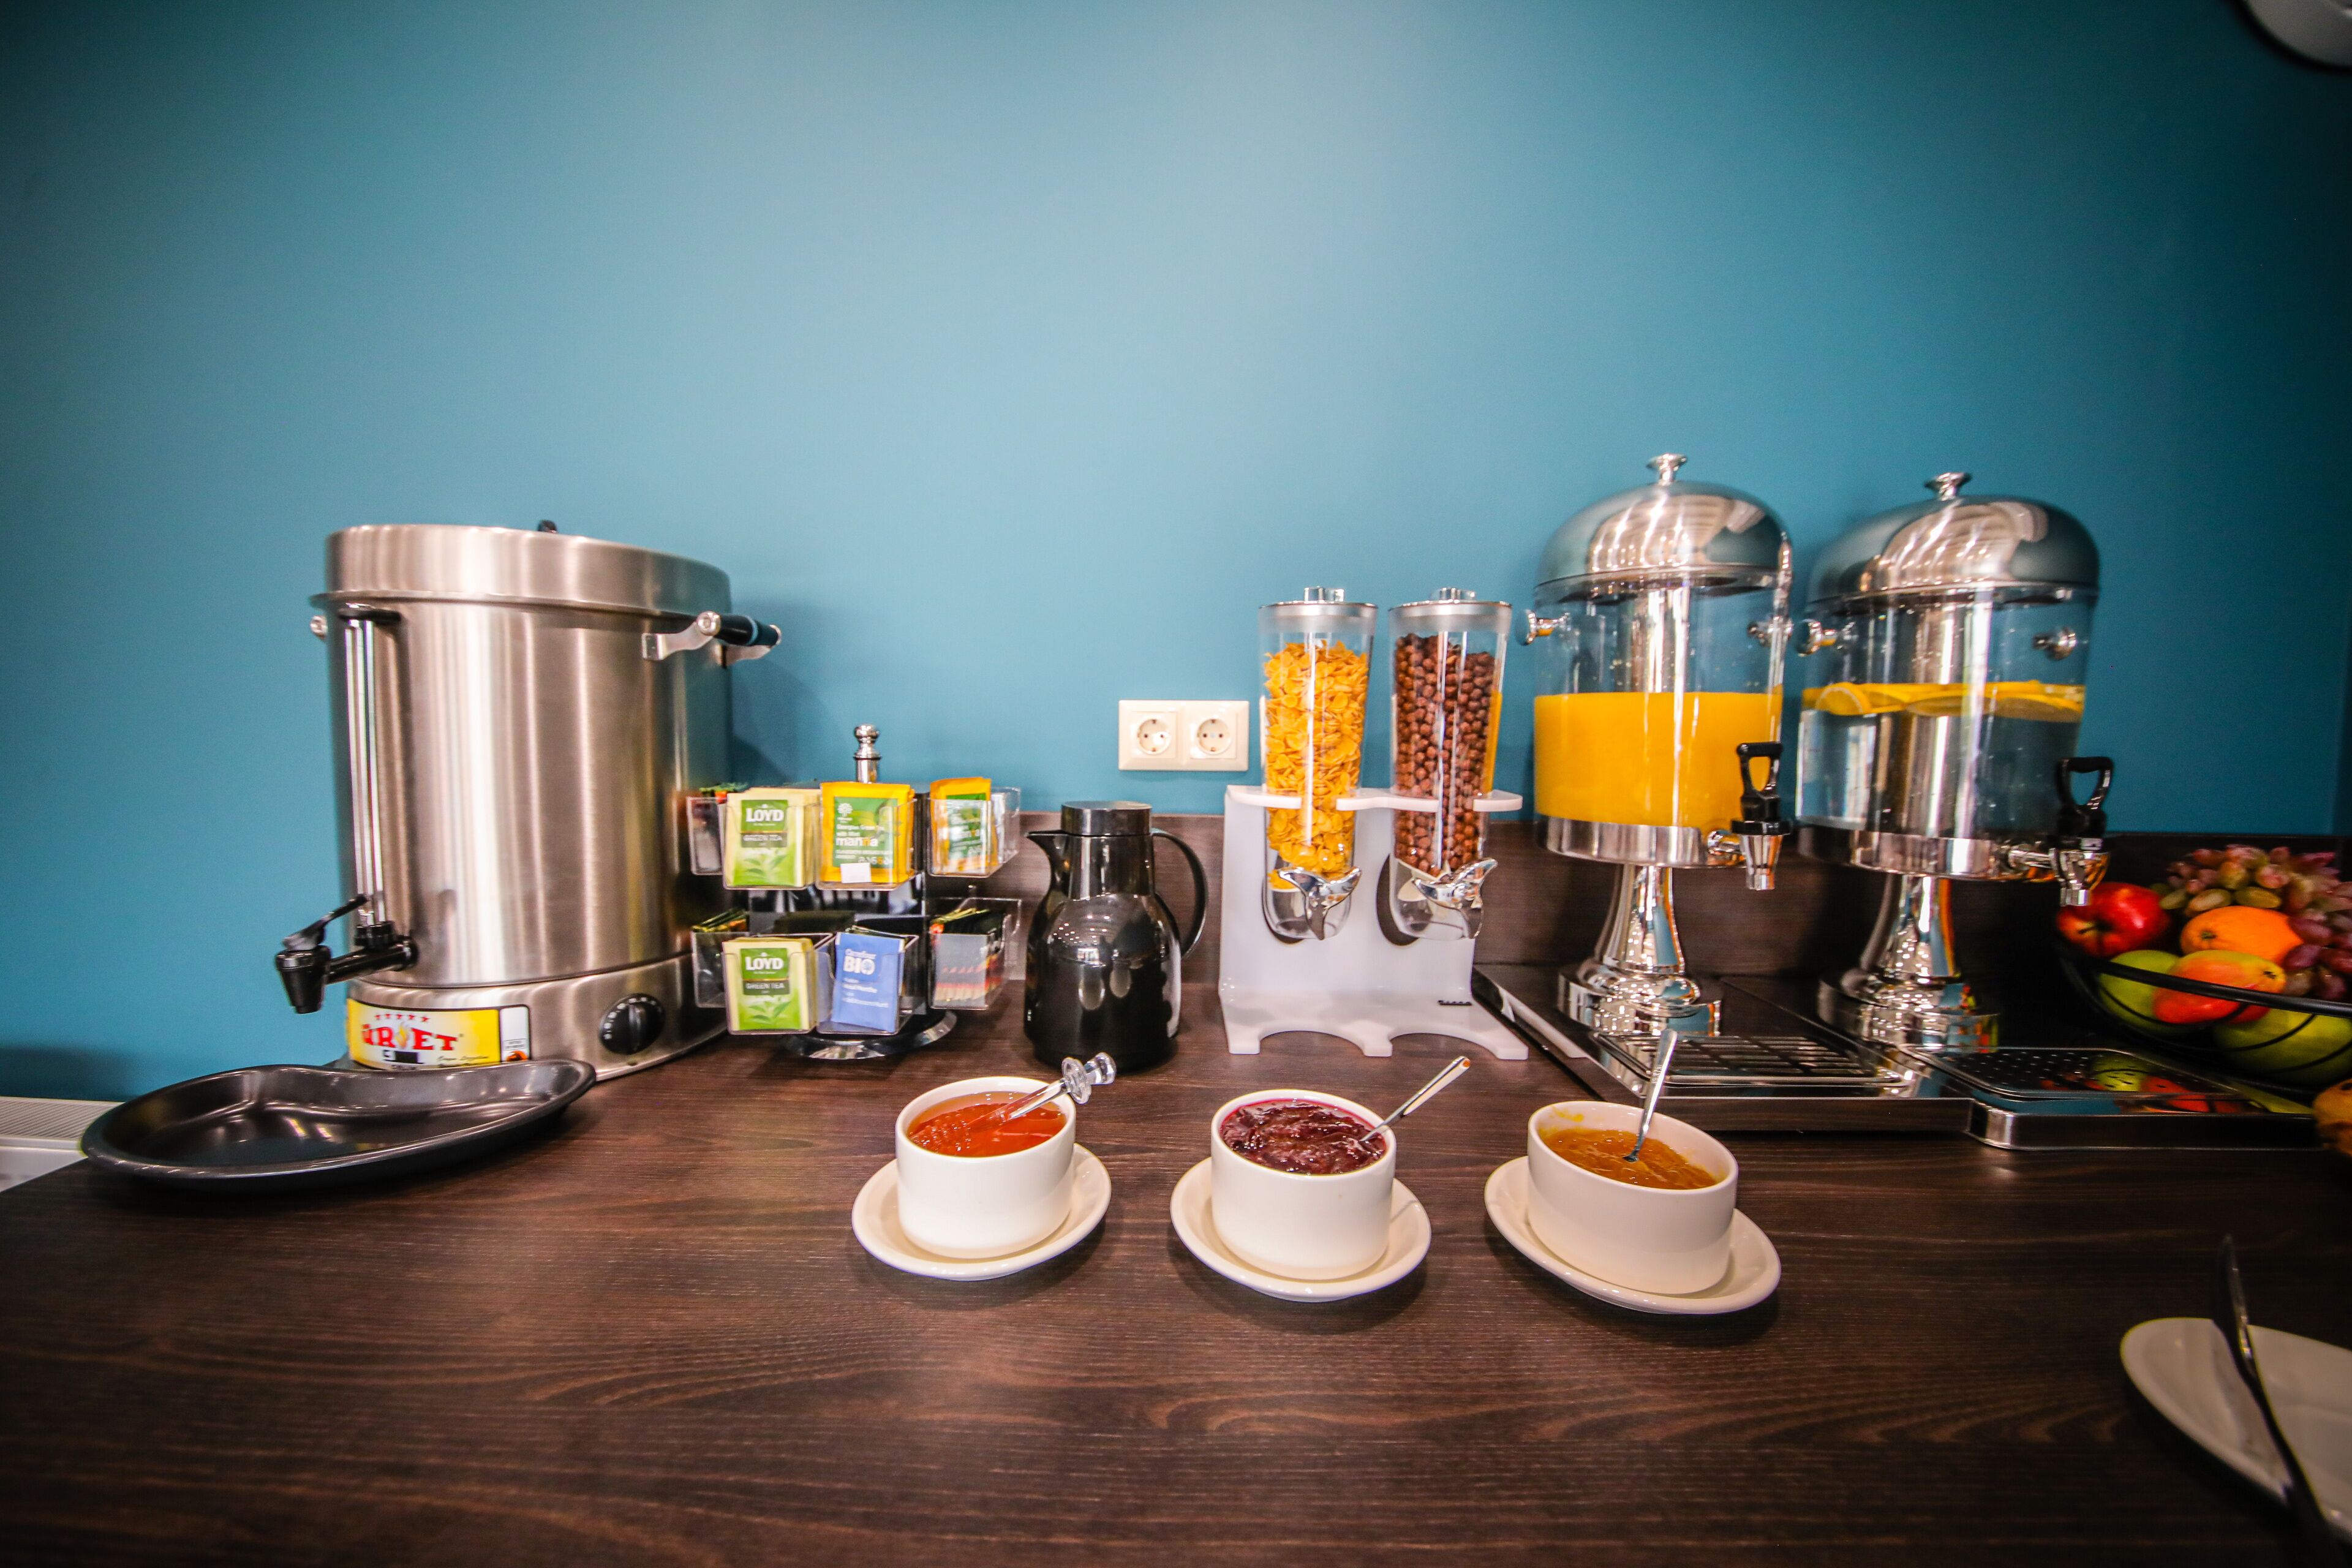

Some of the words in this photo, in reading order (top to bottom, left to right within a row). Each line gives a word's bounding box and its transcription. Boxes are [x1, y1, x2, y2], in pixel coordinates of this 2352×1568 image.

[745, 808, 785, 822] LOYD
[835, 837, 878, 846] manna
[745, 956, 785, 971] LOYD
[843, 956, 876, 975] BIO
